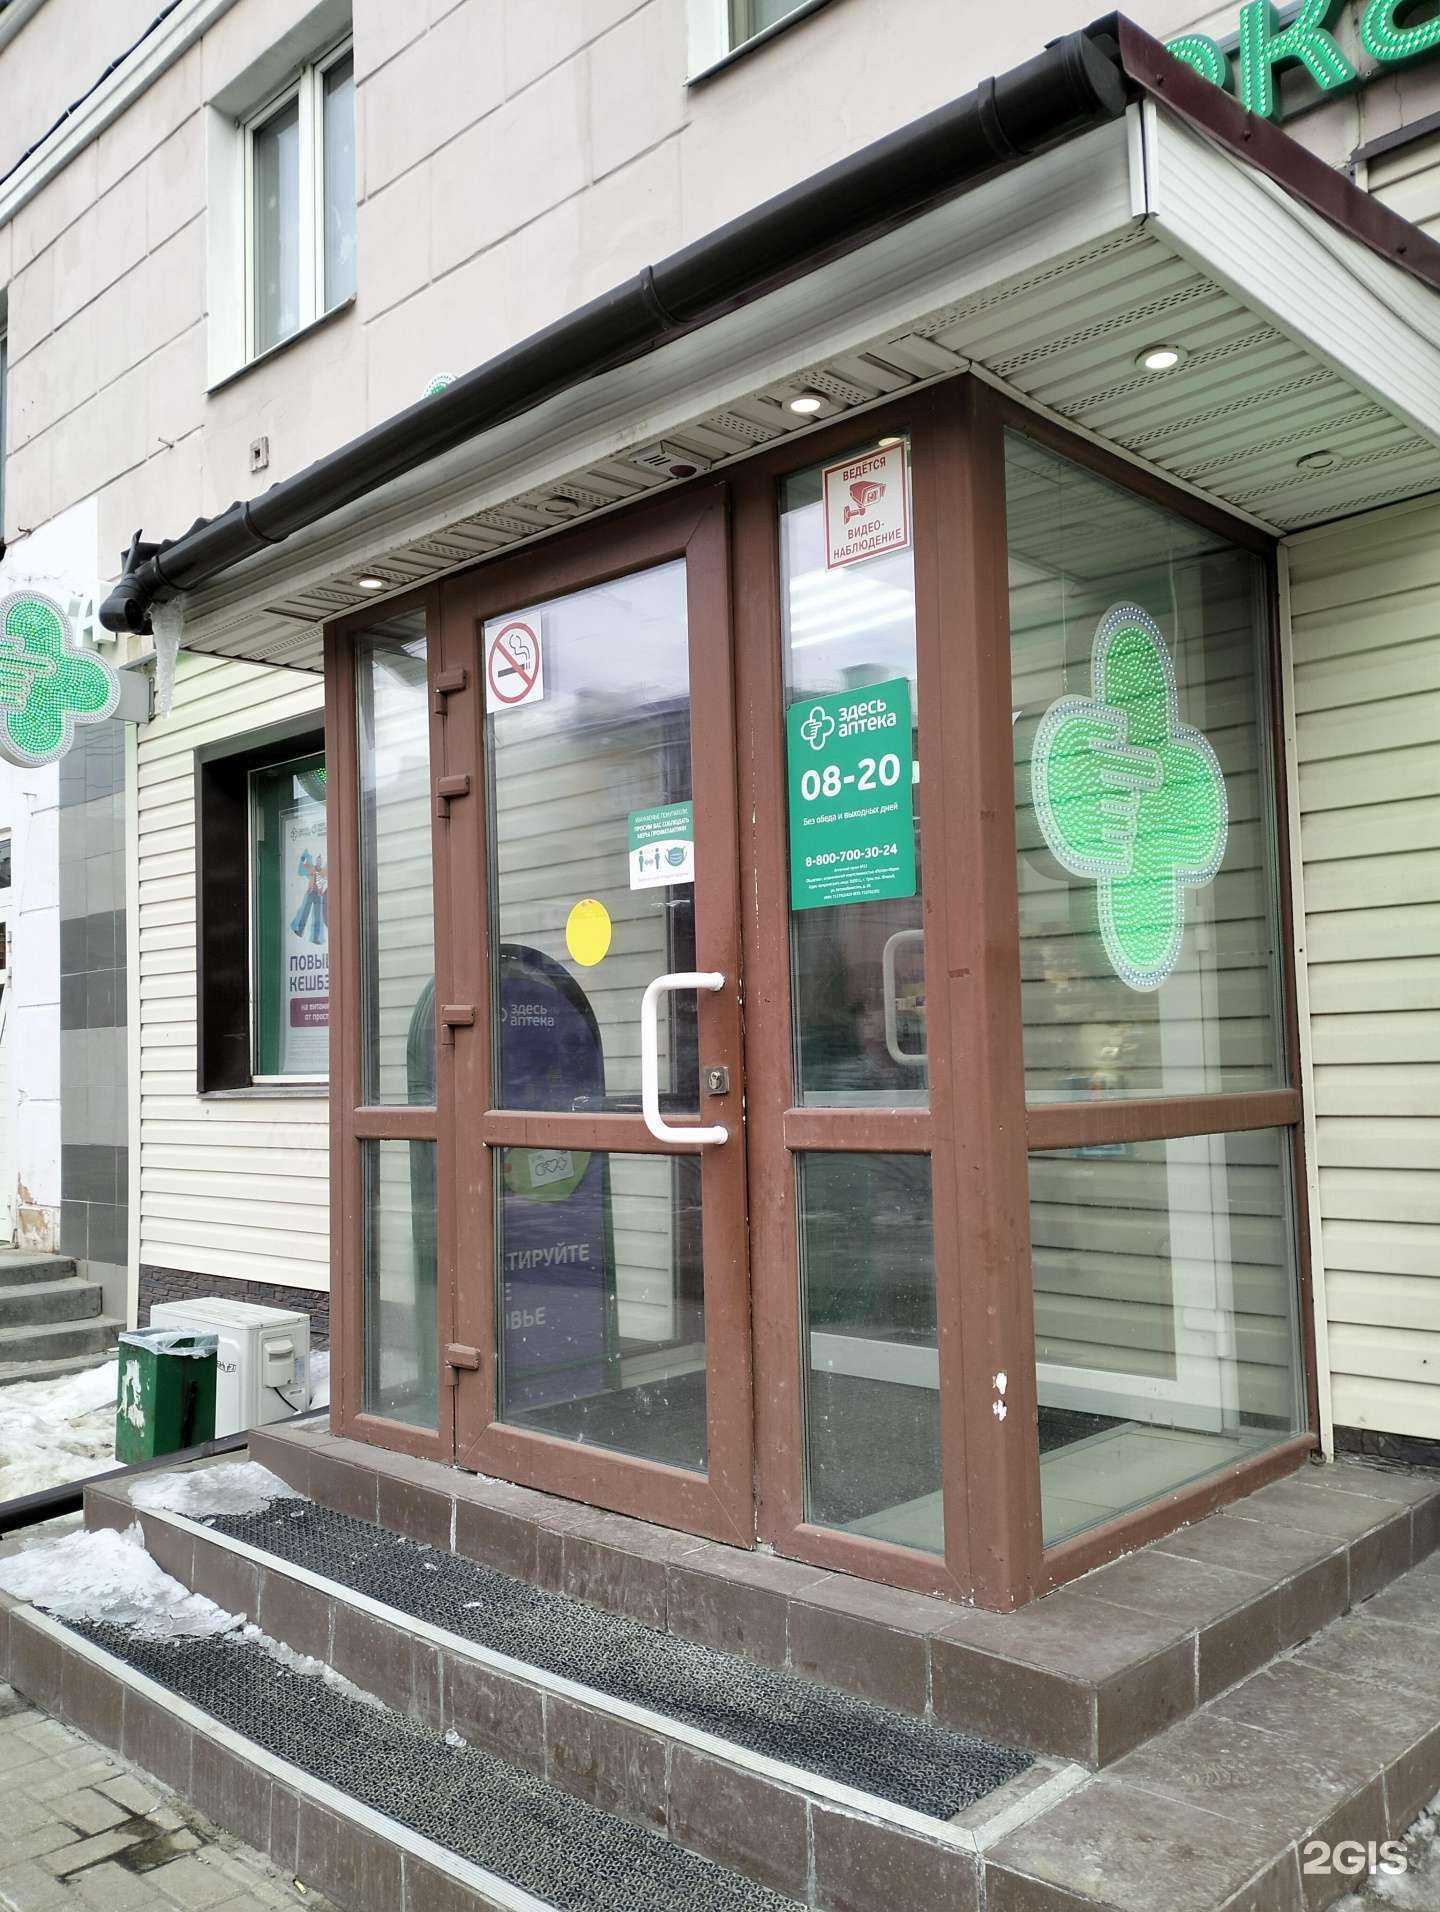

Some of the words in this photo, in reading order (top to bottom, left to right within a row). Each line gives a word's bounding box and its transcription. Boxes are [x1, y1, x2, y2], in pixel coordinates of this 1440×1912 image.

[847, 520, 885, 540] ВИДЕО-
[833, 528, 902, 560] НАБЛЮДЕНИЕ
[838, 698, 887, 722] здесь
[838, 712, 897, 738] аптека
[801, 753, 901, 801] 08-20
[816, 812, 837, 824] обеда
[837, 811, 843, 820] и
[844, 806, 880, 820] выходных
[880, 801, 898, 814] дней
[805, 843, 898, 867] 8-800-700-30-24
[511, 1004, 548, 1015] здесь
[511, 1016, 554, 1027] аптека
[505, 1242, 590, 1272] ТИРУЙТЕ
[505, 1306, 546, 1330] ВЬЕ
